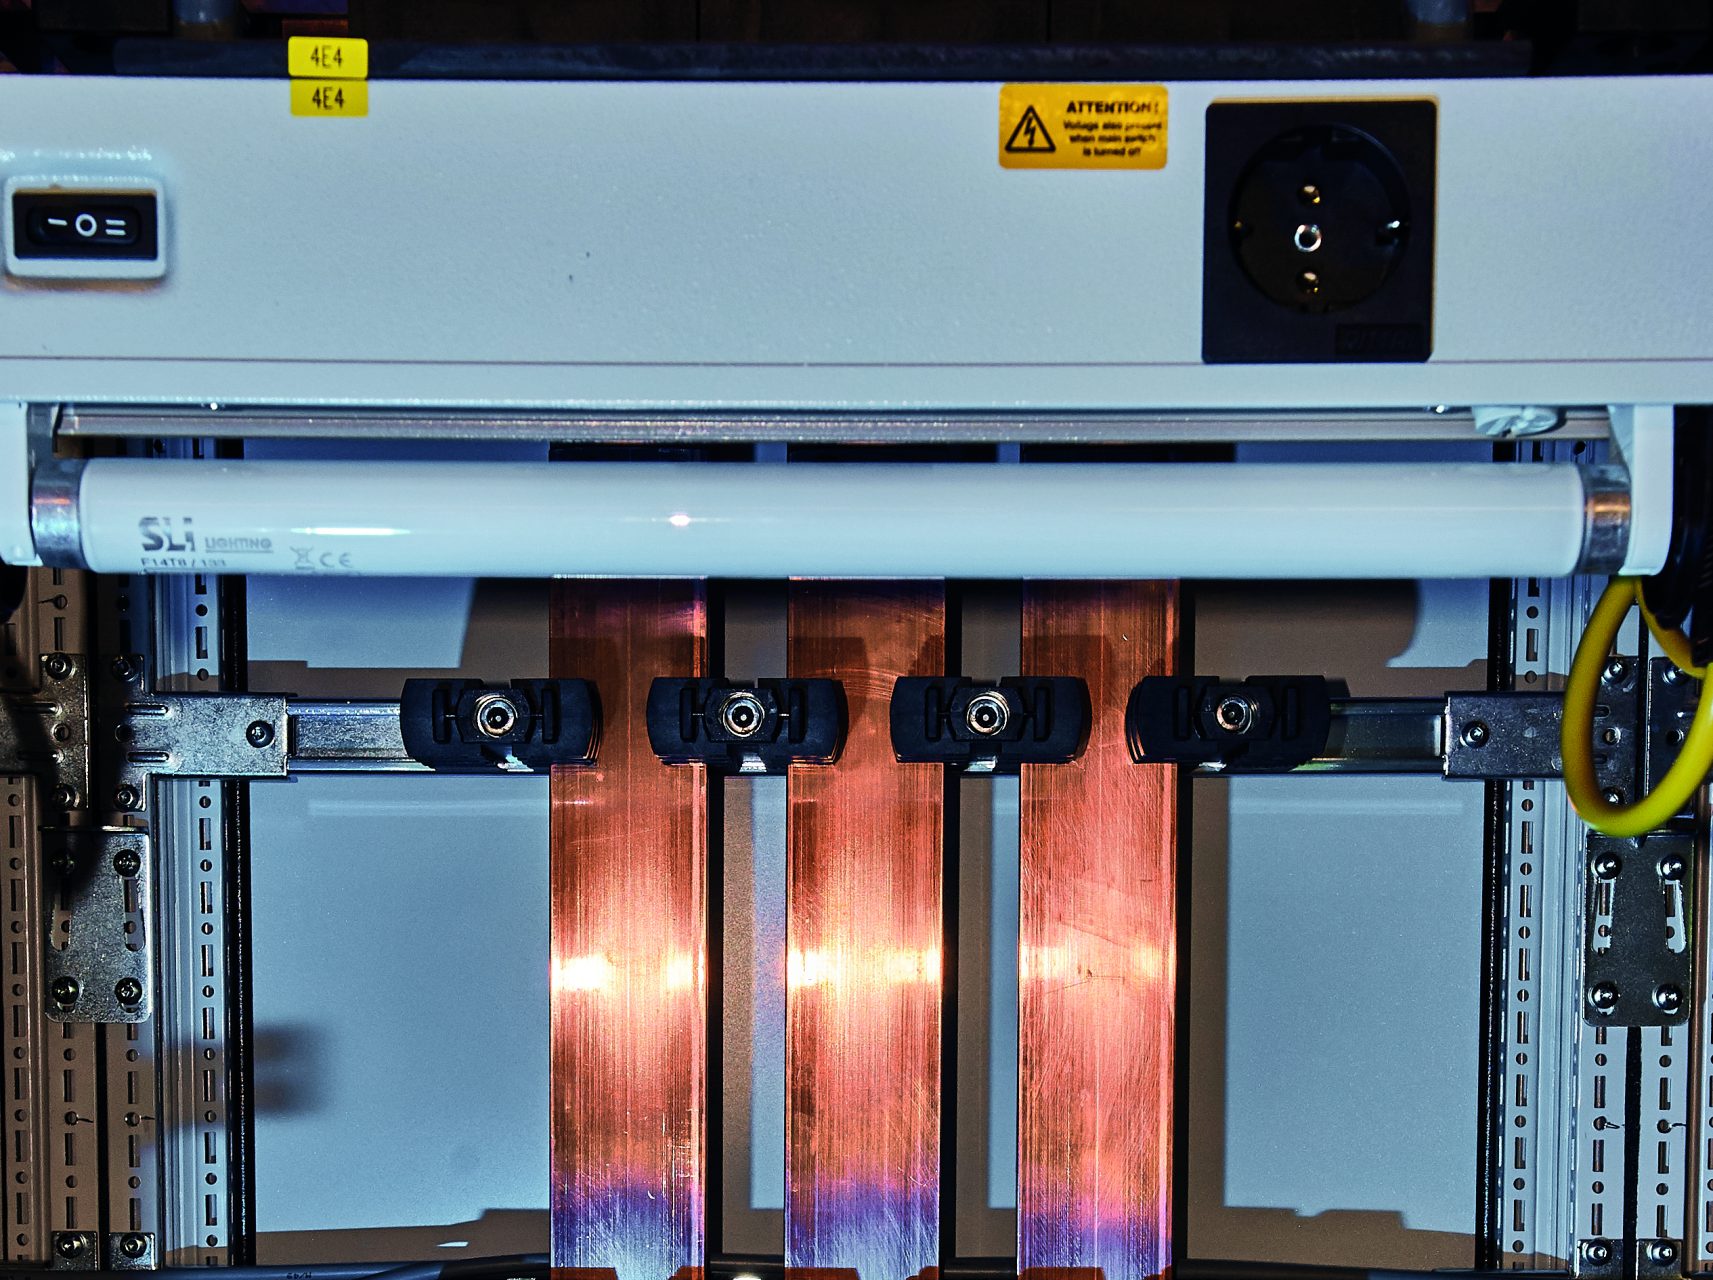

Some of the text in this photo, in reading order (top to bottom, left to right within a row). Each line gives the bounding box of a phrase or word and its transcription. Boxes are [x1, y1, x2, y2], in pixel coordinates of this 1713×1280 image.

[310, 45, 343, 68] 4E4
[312, 86, 345, 110] 4E4
[205, 537, 273, 550] LIGHTING
